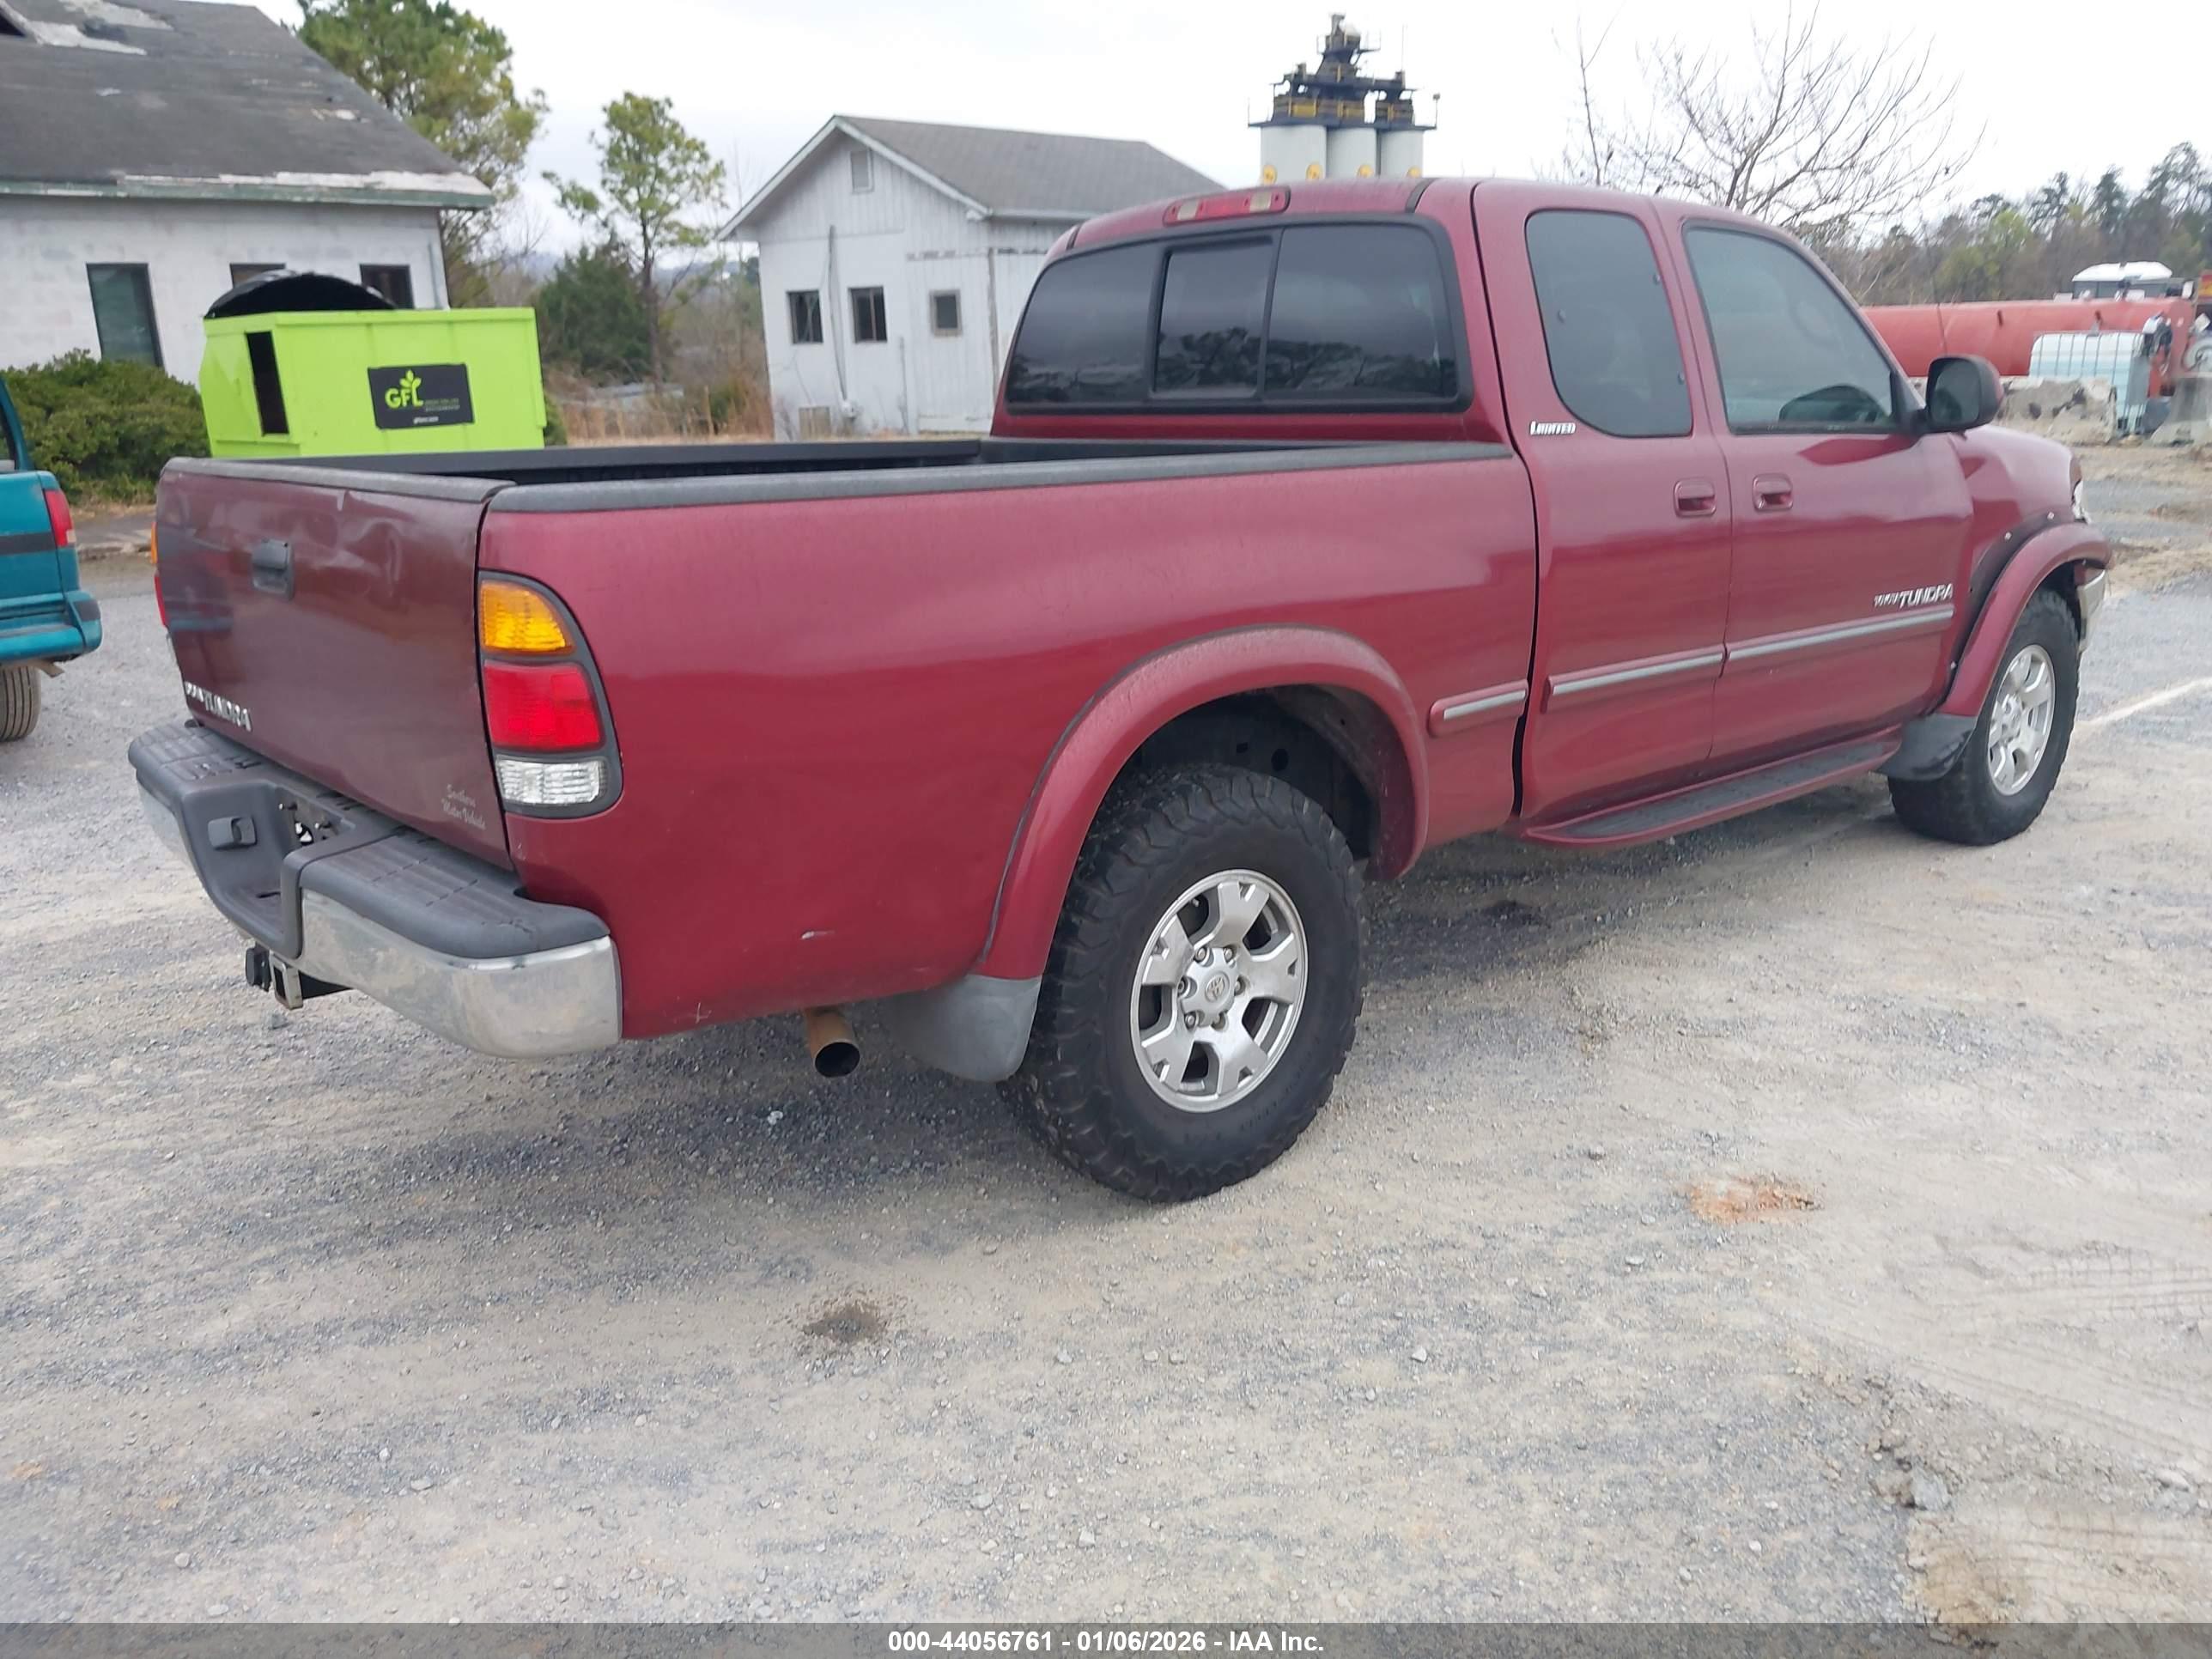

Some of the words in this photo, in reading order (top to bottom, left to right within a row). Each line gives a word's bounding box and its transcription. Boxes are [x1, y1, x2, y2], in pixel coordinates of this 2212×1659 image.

[384, 378, 424, 410] GFL
[1899, 583, 1954, 610] TUNDRA
[204, 689, 252, 732] TUNDRA
